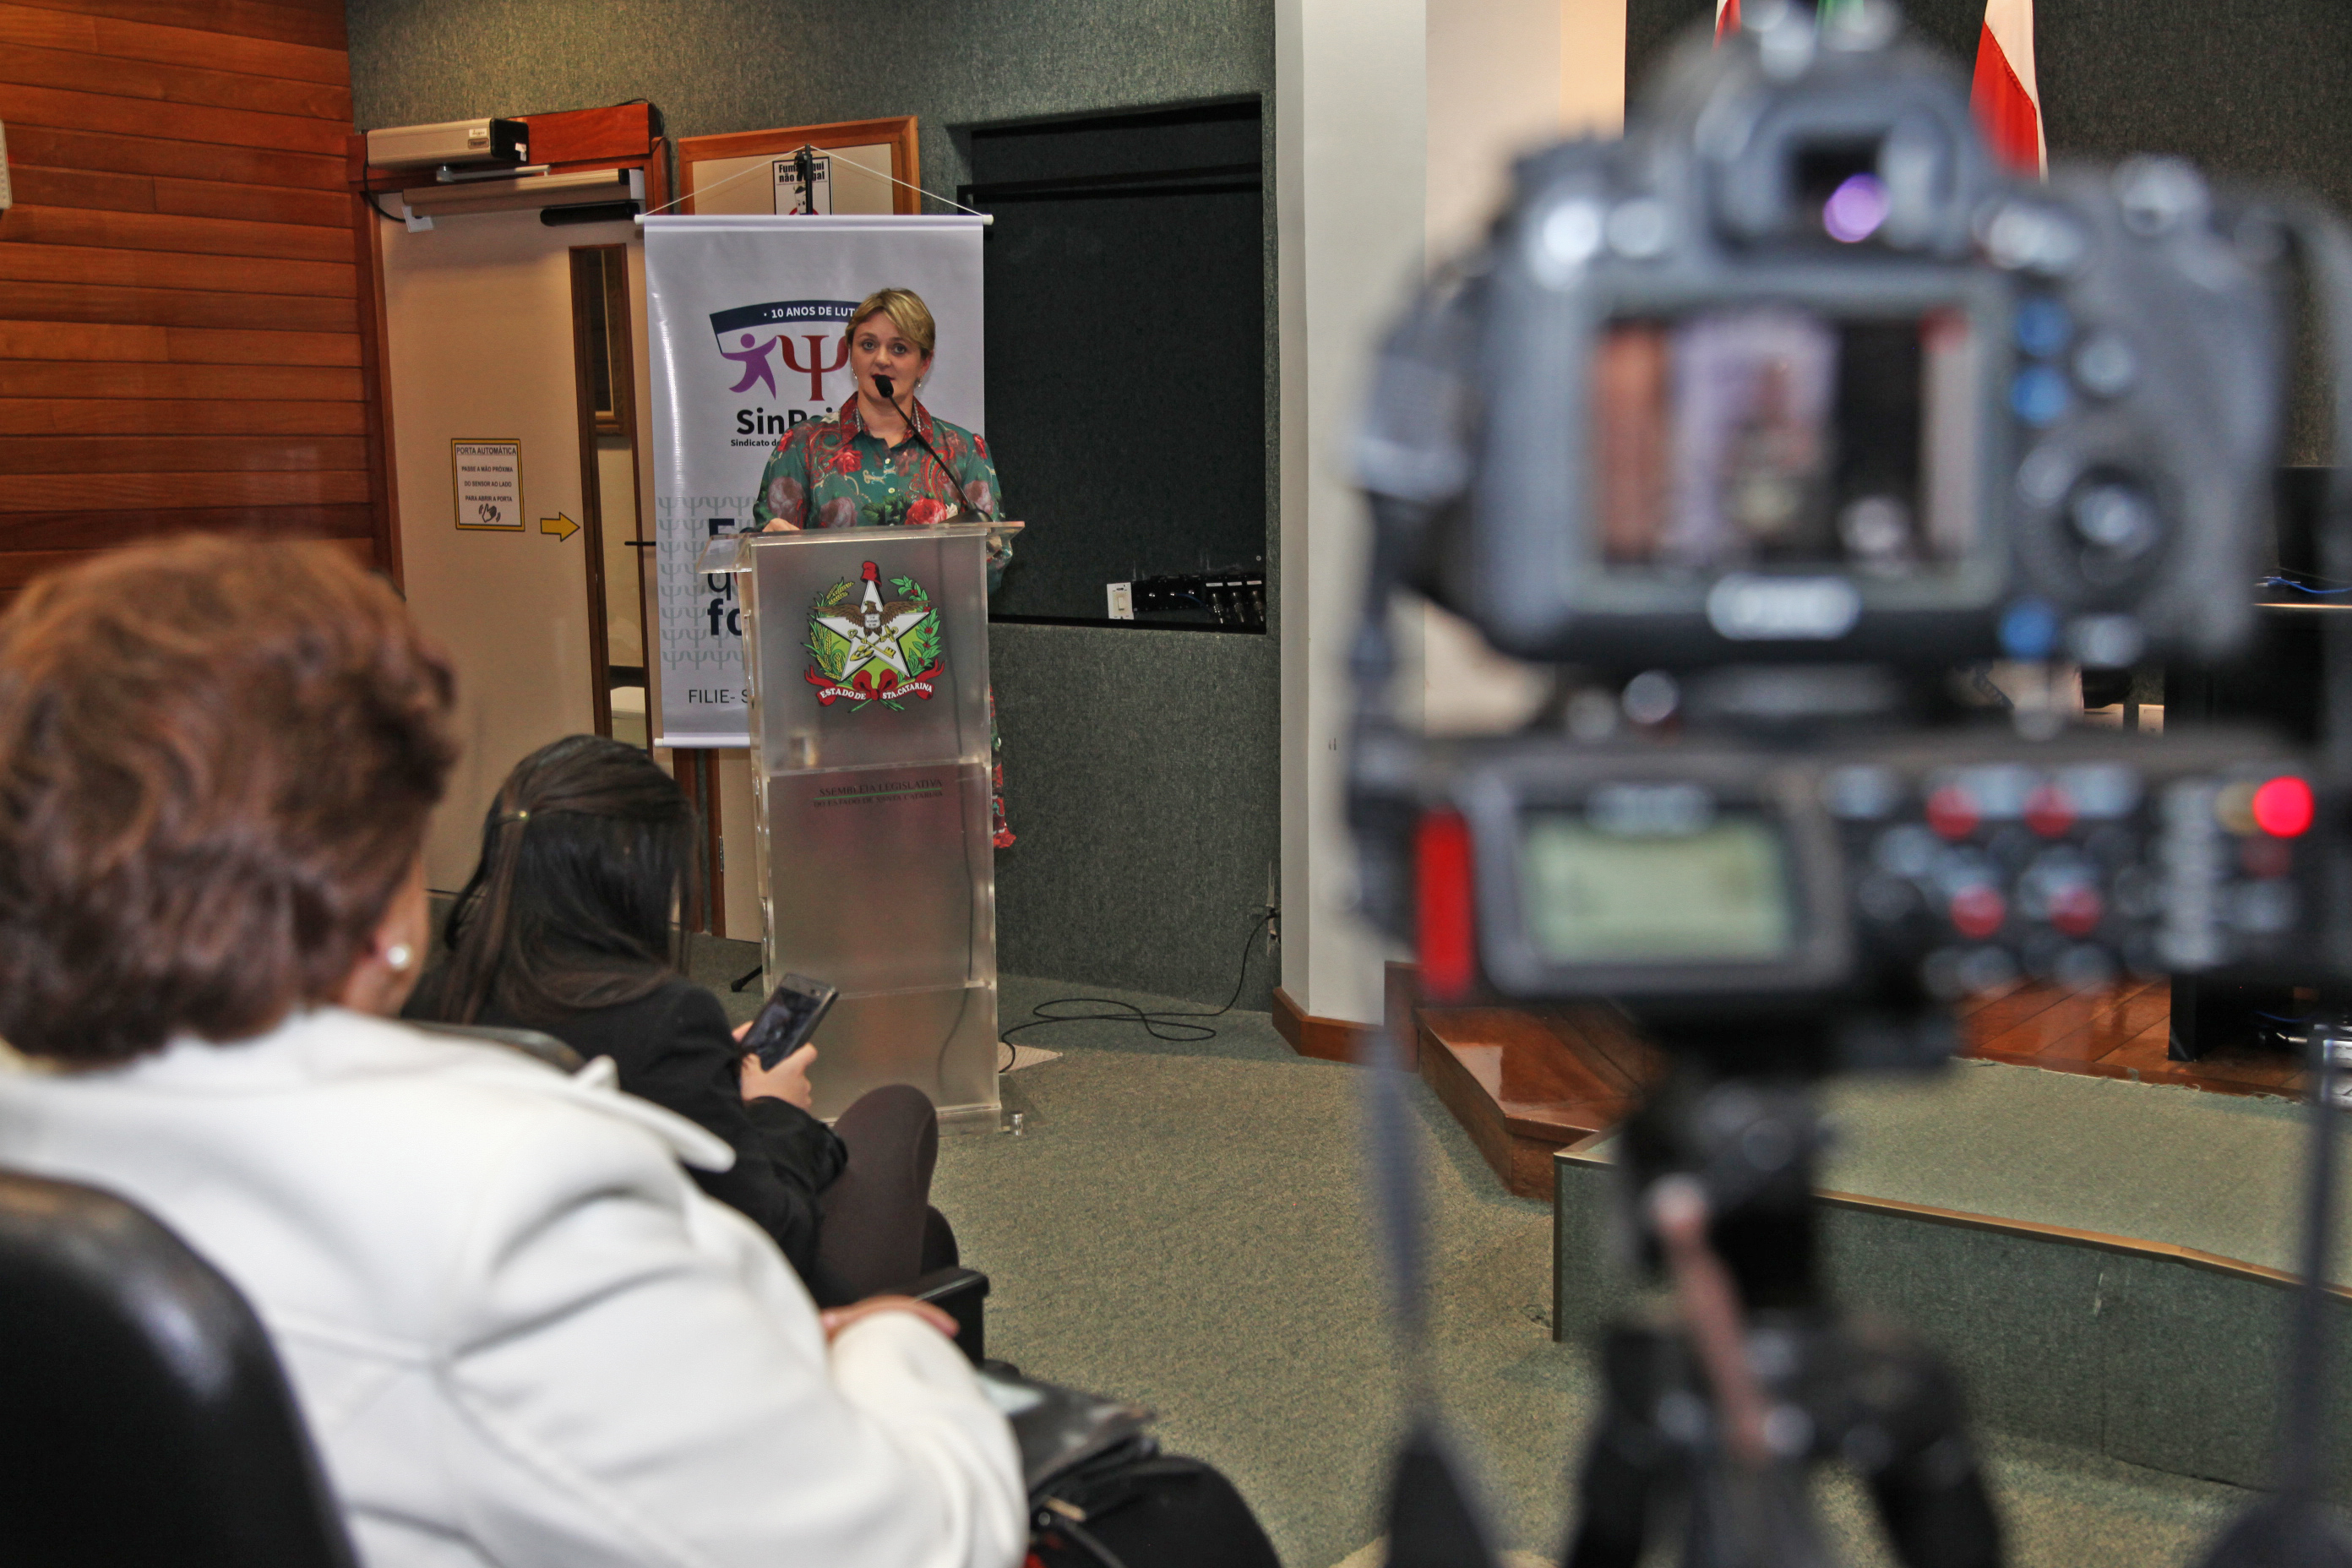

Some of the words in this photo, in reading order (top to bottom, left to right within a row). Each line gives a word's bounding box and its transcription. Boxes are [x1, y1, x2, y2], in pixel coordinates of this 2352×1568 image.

[779, 164, 798, 173] Fum
[779, 173, 795, 182] não
[771, 308, 784, 318] 10
[786, 306, 816, 318] ANOS
[818, 306, 832, 316] DE
[835, 307, 858, 317] LUT
[730, 438, 770, 447] Sindicato
[477, 446, 517, 455] AUTOMÁTICA
[689, 689, 736, 704] FILIE-
[819, 688, 855, 699] ESTADO
[853, 692, 867, 700] DE
[879, 778, 942, 792] LEGISLATIVA
